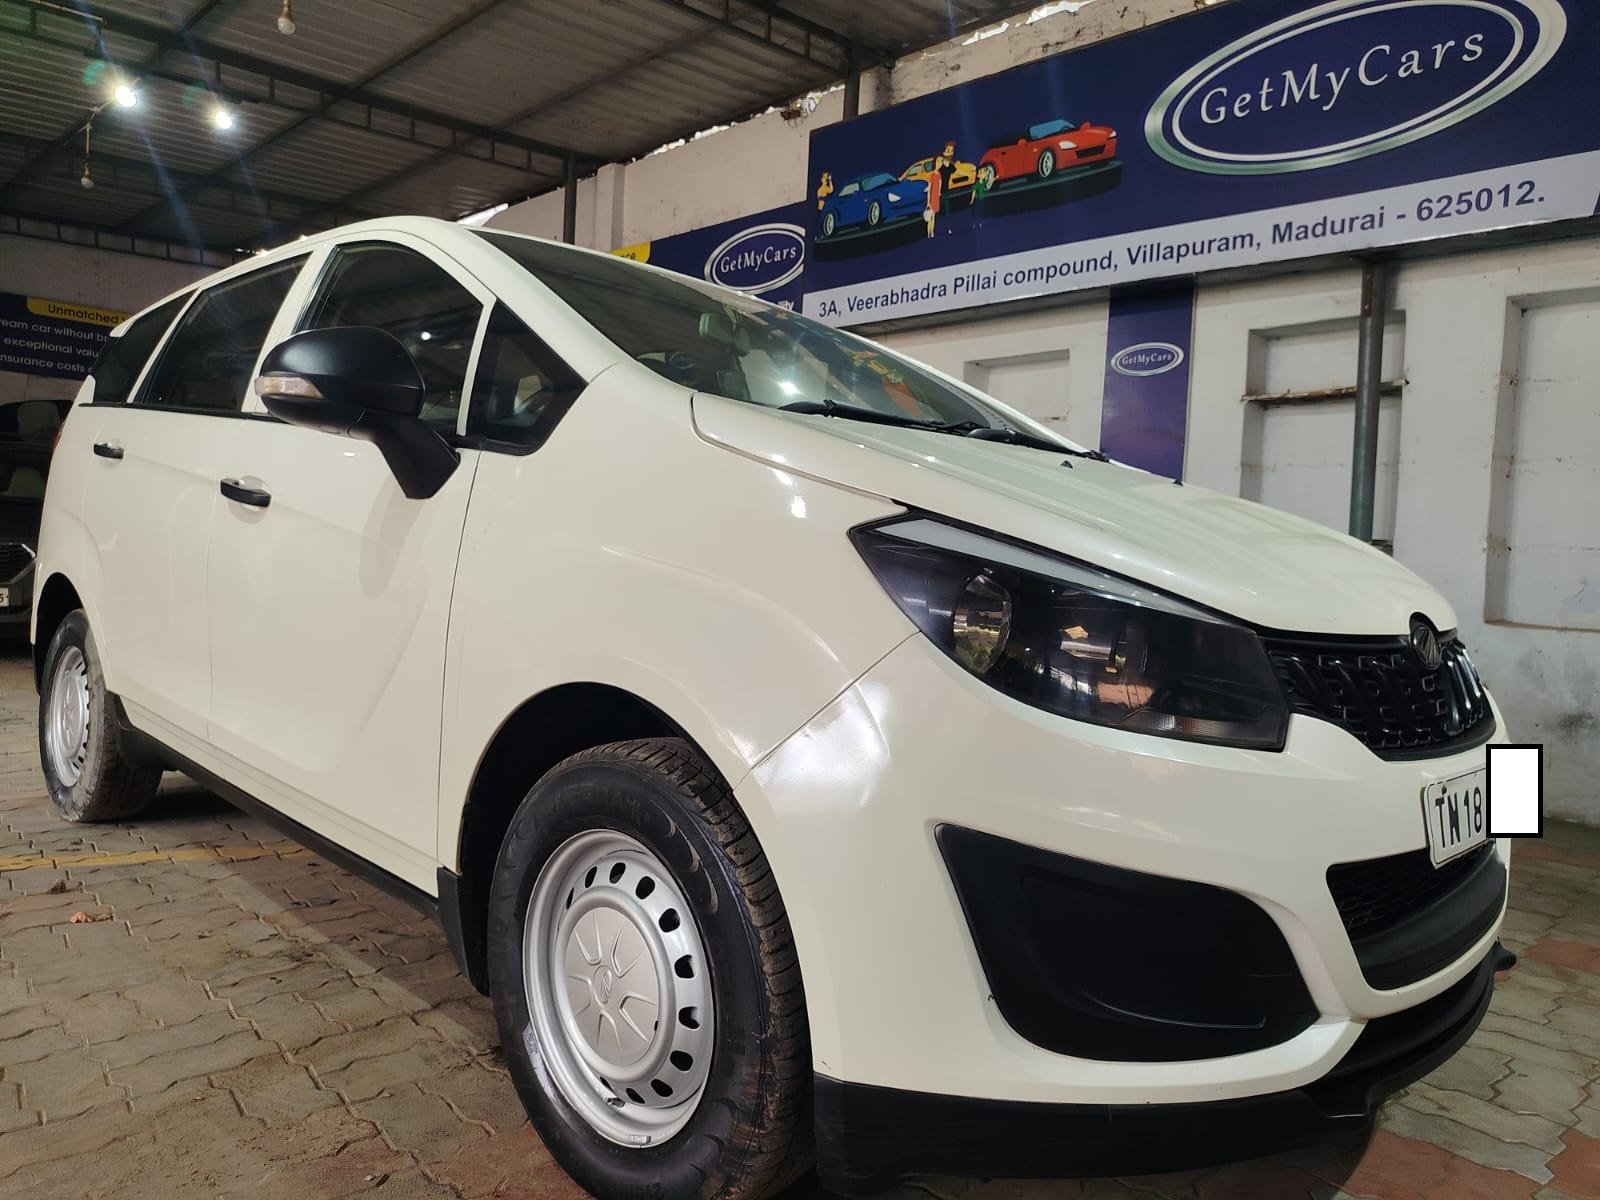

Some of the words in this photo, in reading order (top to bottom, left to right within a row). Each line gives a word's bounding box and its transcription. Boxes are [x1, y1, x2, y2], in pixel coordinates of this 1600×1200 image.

[1200, 32, 1485, 126] GetMyCars
[819, 301, 842, 318] 3A,
[847, 281, 947, 313] Veerabhadra
[953, 270, 998, 294] Pillai
[1003, 249, 1120, 285] compound,
[1126, 231, 1262, 265] Villapuram,
[1271, 205, 1385, 245] Madurai
[1416, 179, 1545, 223] 625012.
[719, 246, 797, 273] GetMyCars
[48, 303, 119, 324] Unmatched
[32, 324, 51, 333] car
[54, 327, 94, 341] without
[4, 337, 73, 354] exceptional
[76, 346, 99, 358] valu
[0, 354, 54, 368] nsurance
[57, 361, 85, 373] costs
[1122, 352, 1172, 366] GetMyCars
